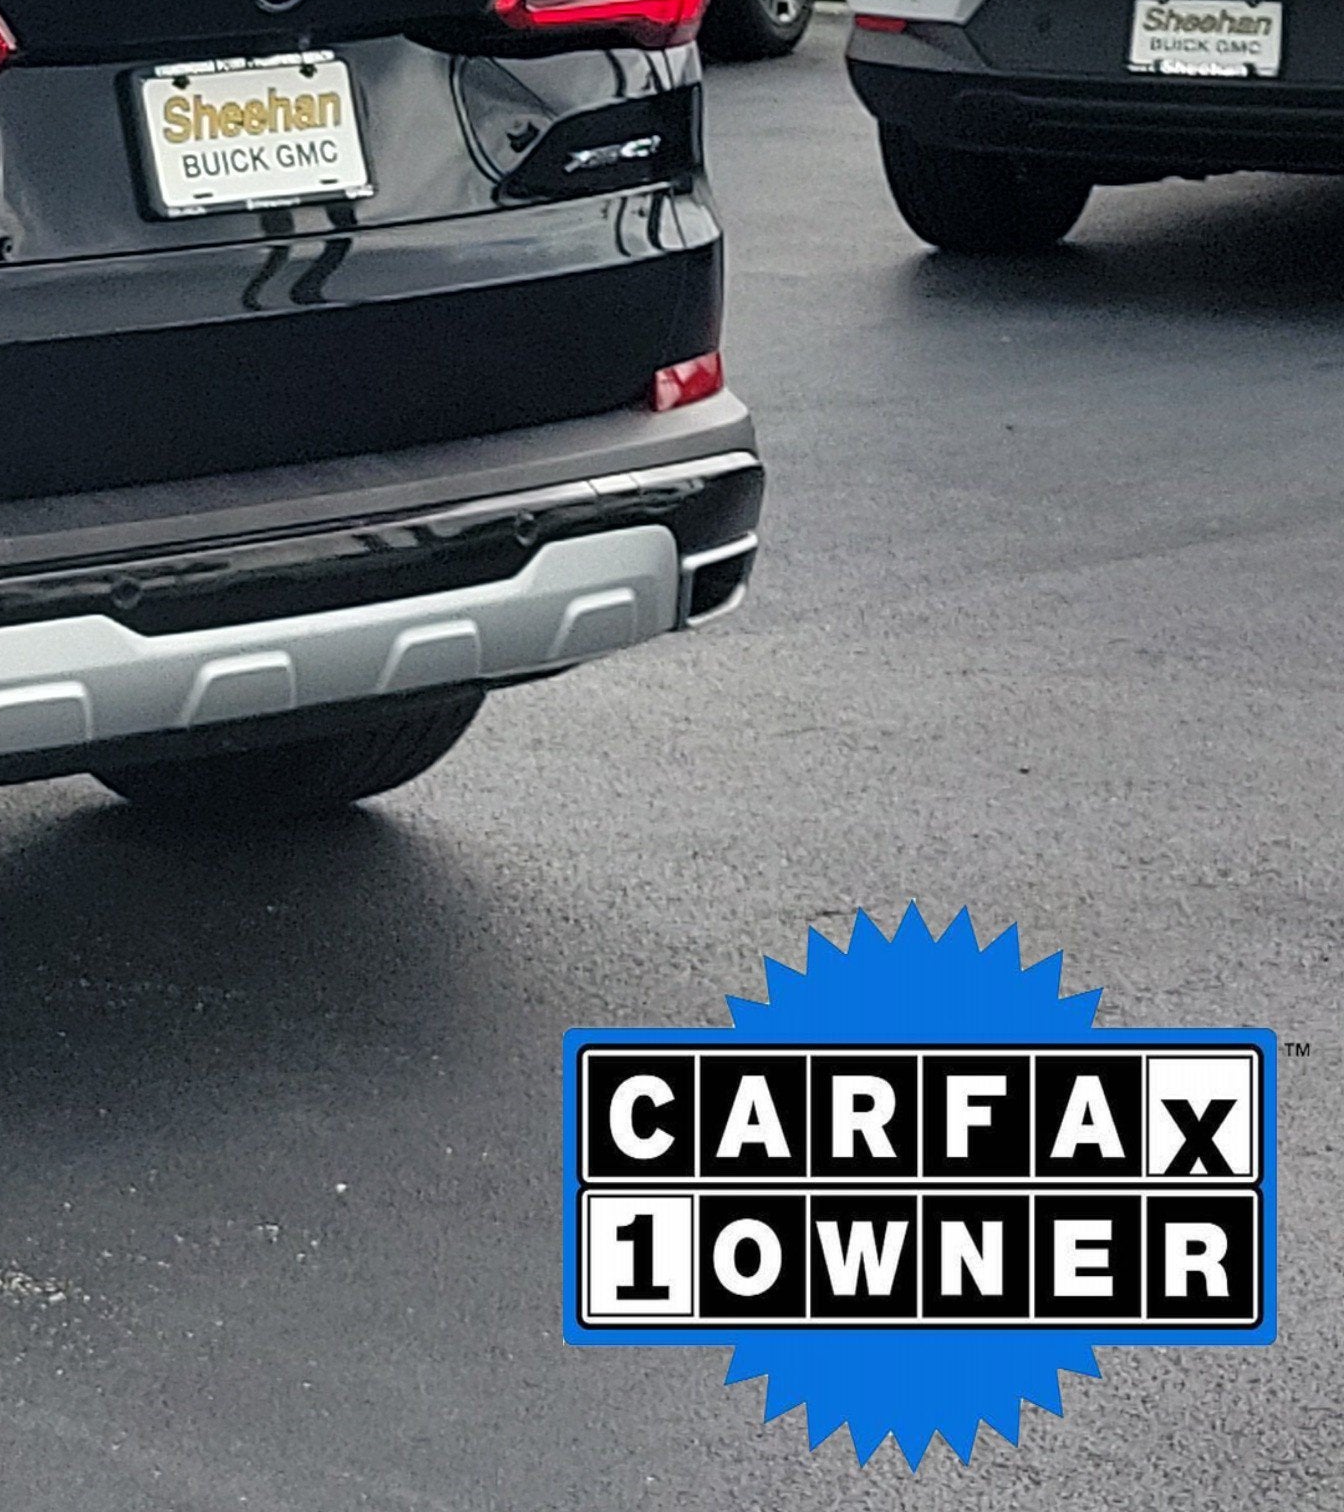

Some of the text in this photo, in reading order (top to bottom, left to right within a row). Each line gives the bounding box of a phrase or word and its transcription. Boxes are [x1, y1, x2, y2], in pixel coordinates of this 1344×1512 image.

[1142, 6, 1273, 36] Sheehan
[163, 87, 342, 144] Sheehan
[181, 139, 338, 179] BUICK GMC
